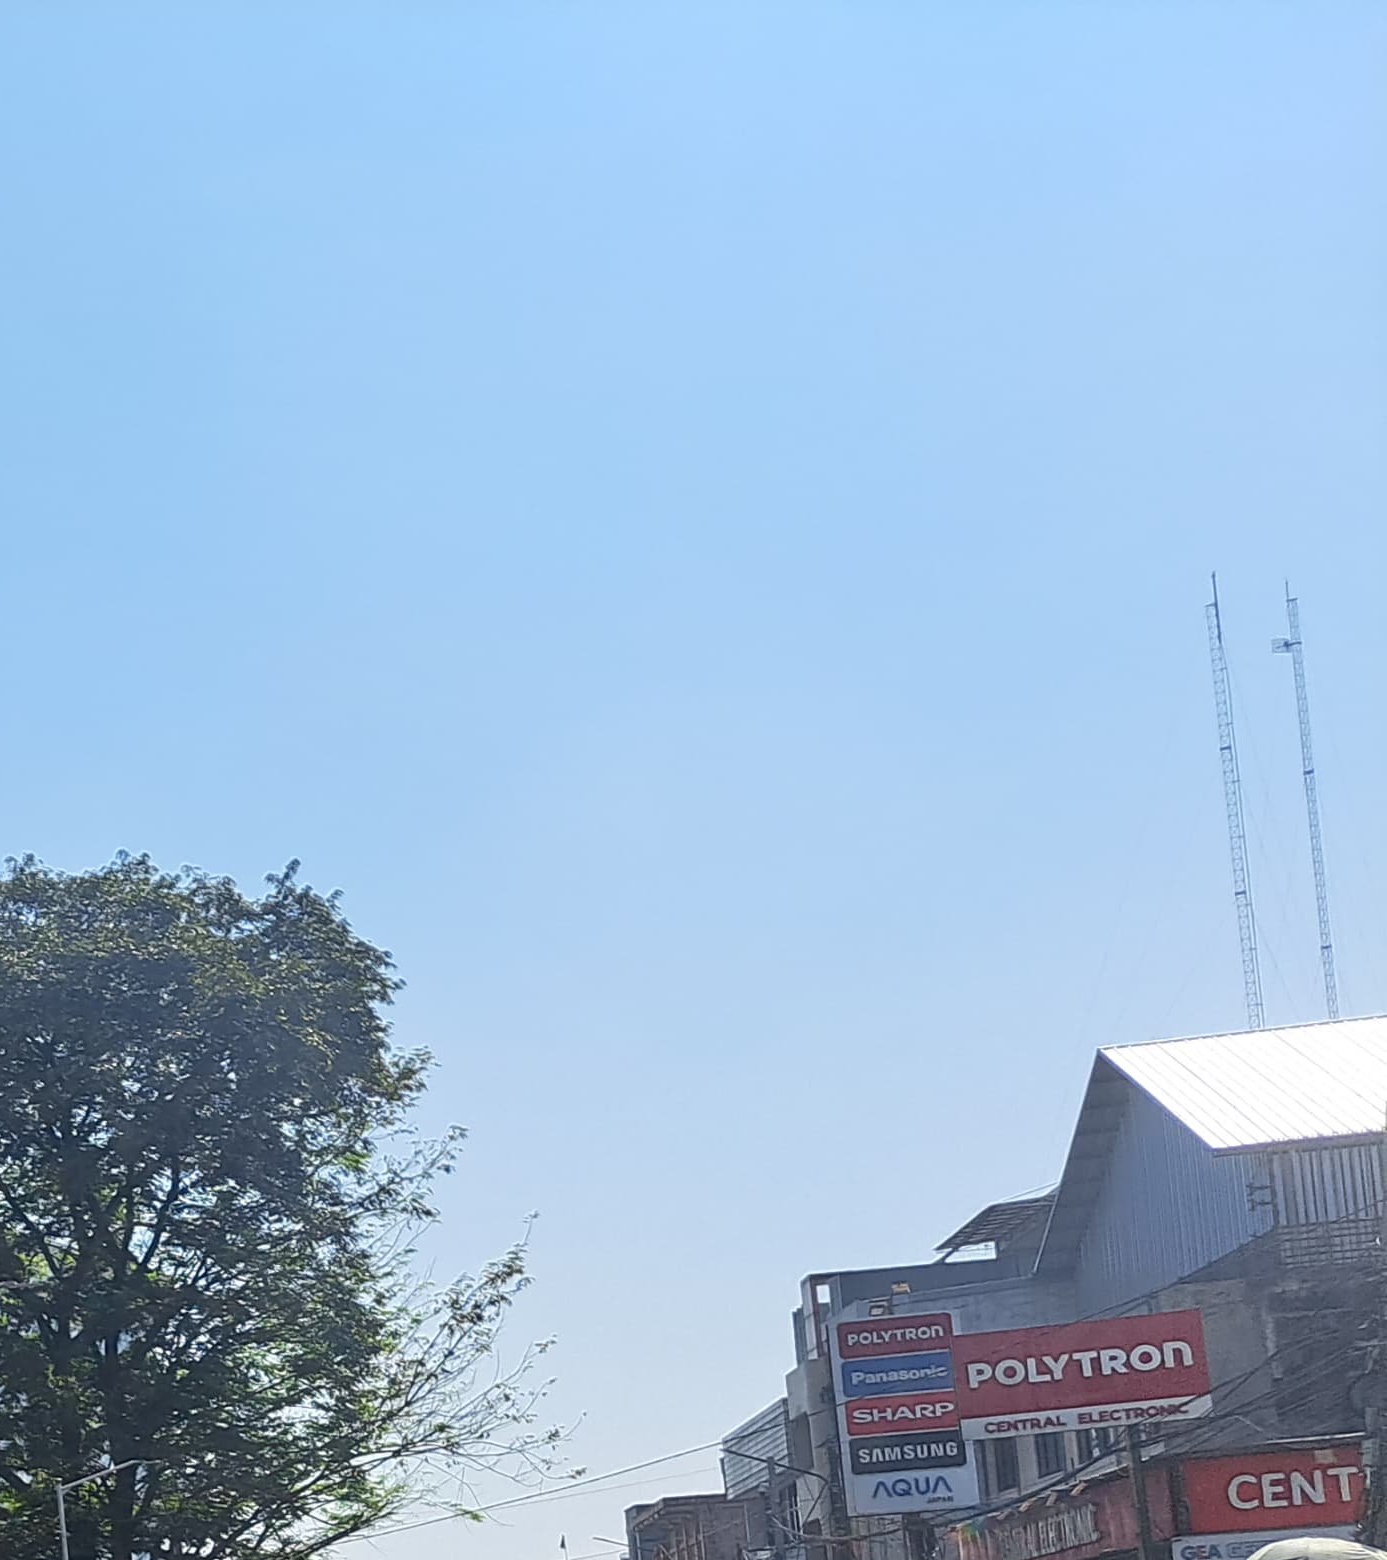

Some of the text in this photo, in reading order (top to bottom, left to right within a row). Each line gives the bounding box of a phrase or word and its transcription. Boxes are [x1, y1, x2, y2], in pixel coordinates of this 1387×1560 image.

[847, 1325, 944, 1346] POLYTRON
[966, 1340, 1195, 1389] POLYTRON
[850, 1365, 948, 1386] Panasonic
[852, 1402, 955, 1423] SHARP
[984, 1404, 1189, 1434] CENTRAL ELECTRONIC
[857, 1442, 958, 1463] SAMSUNG
[872, 1476, 953, 1499] AQUA
[1180, 1544, 1222, 1560] GEA
